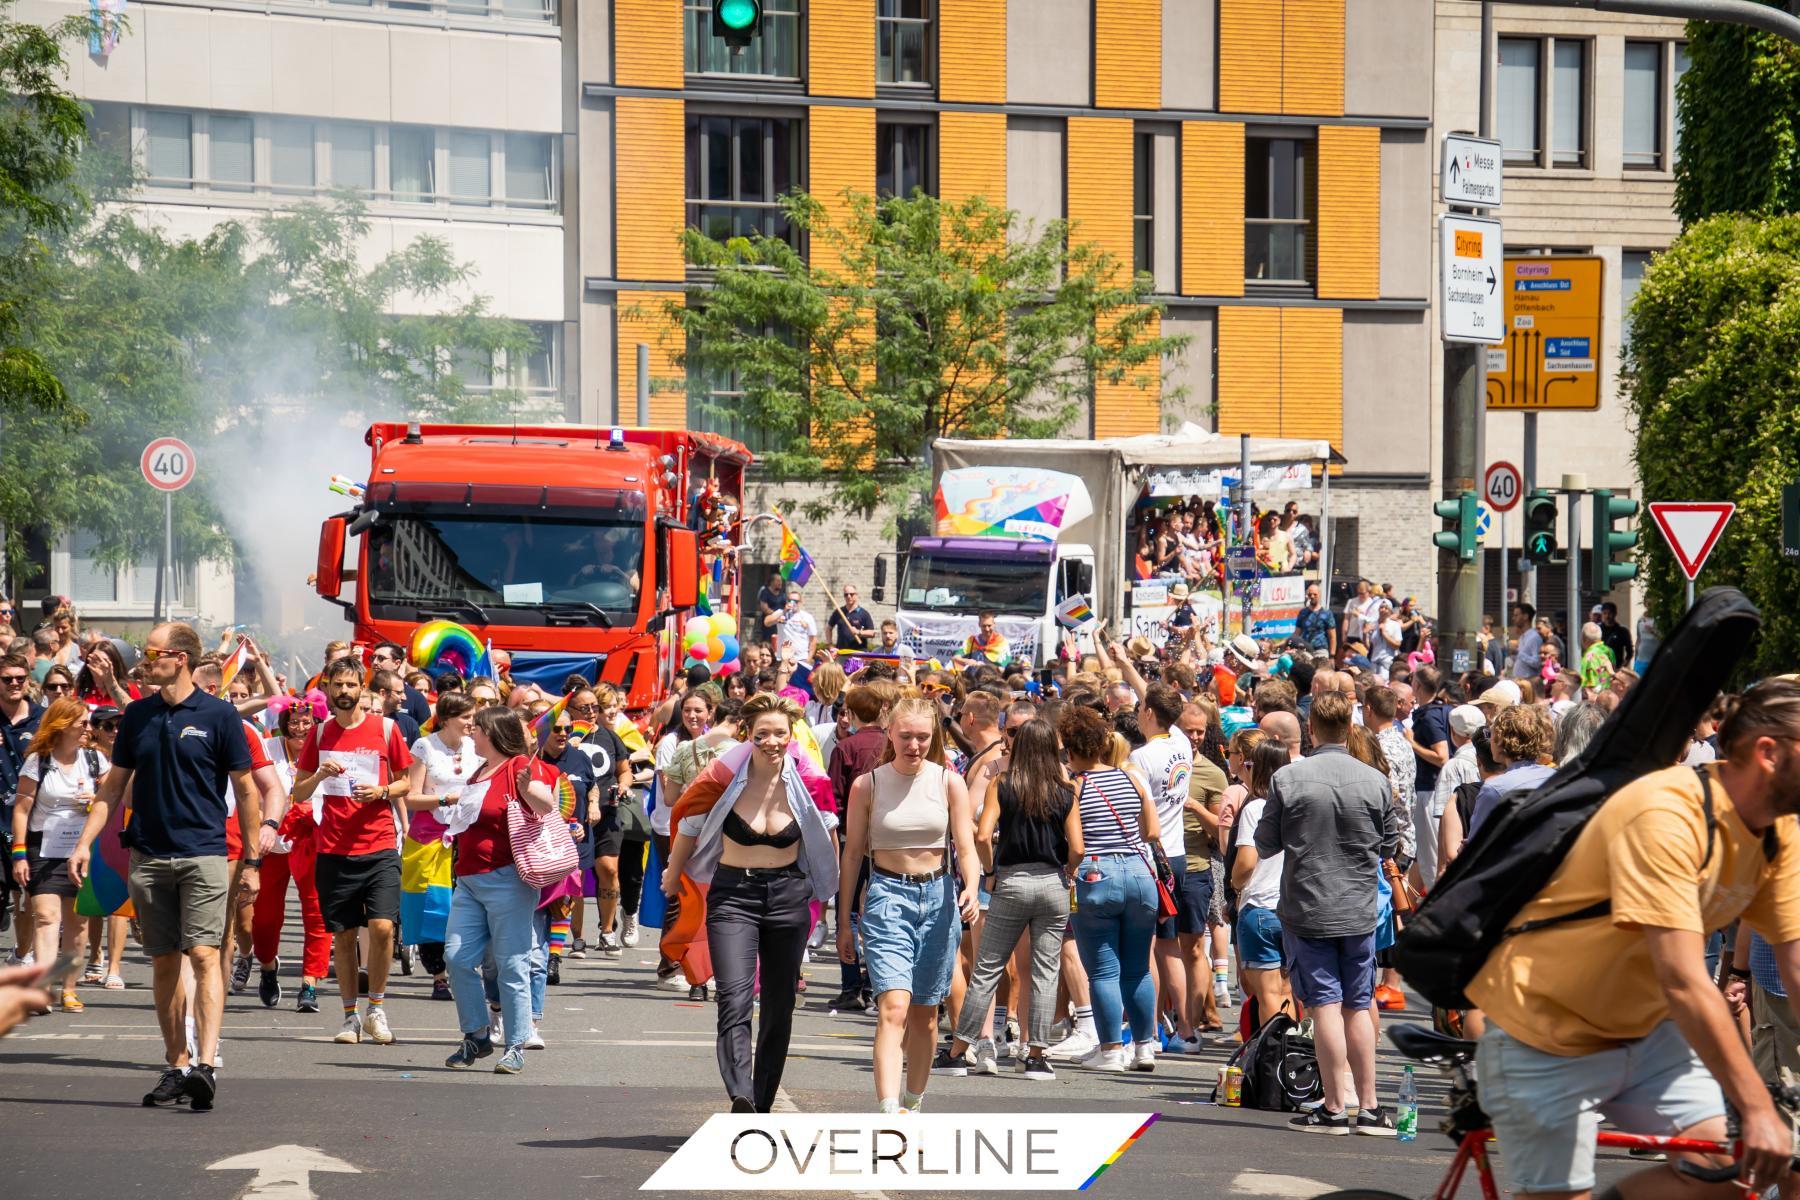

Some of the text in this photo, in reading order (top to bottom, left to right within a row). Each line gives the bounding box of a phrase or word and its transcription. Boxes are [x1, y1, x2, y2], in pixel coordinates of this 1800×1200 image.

[1474, 152, 1494, 170] Messe
[1462, 178, 1494, 199] Palmengarten
[1456, 235, 1481, 257] Cityring
[1453, 264, 1483, 281] Bornheim
[1516, 265, 1550, 275] Cityring
[1448, 286, 1484, 305] Sachsenhausen
[1514, 303, 1555, 312] Offenbach
[1472, 311, 1485, 328] Zoo
[1516, 317, 1532, 326] Zoo
[1547, 362, 1593, 370] Sachsenhausen
[153, 452, 184, 476] 40
[1490, 474, 1514, 498] 40
[1164, 753, 1186, 774] DIESEL
